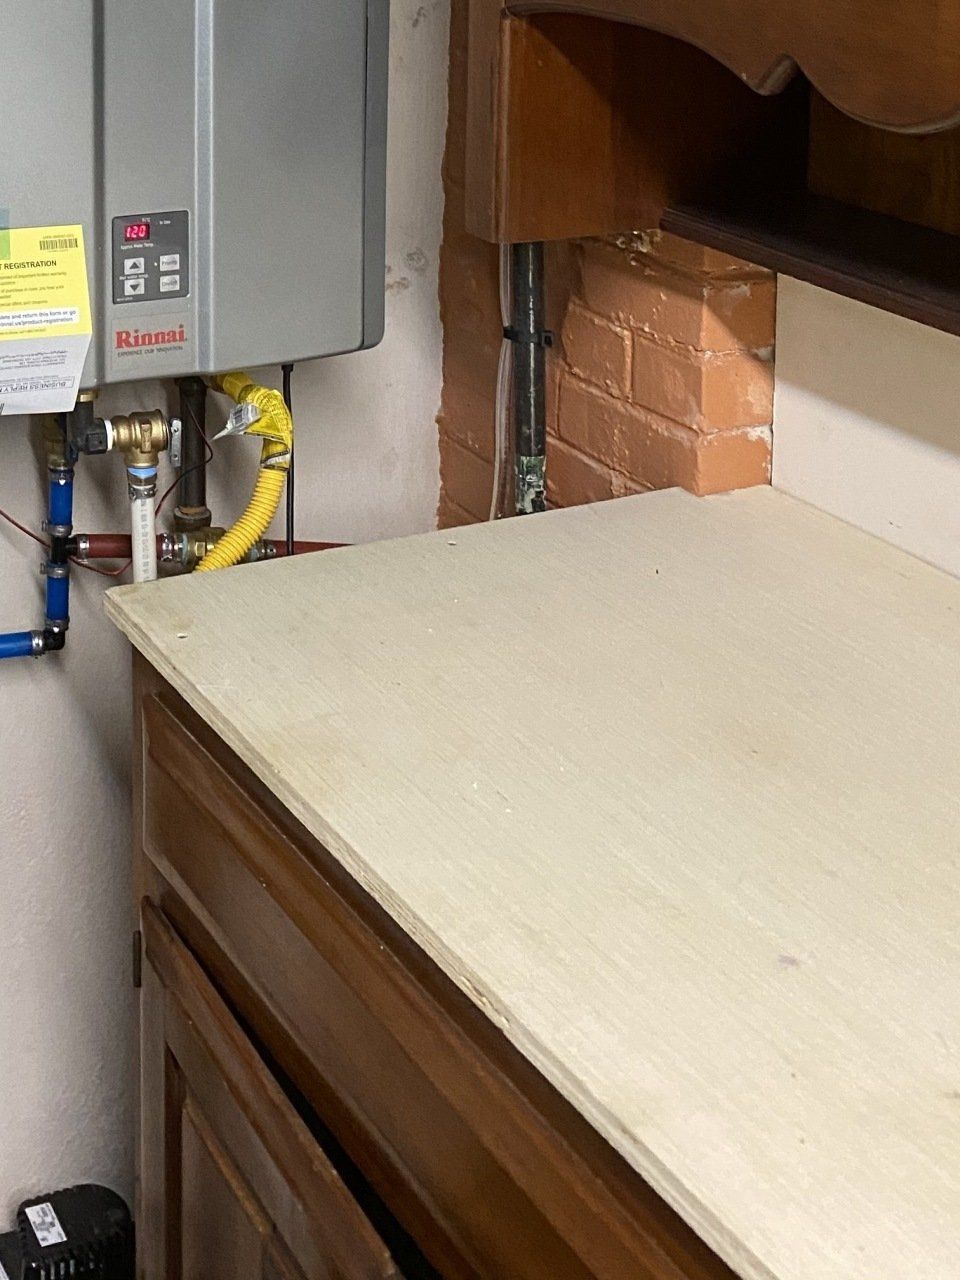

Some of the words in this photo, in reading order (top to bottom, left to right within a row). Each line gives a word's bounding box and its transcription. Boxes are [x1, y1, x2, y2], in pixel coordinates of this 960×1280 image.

[126, 225, 146, 238] 120
[3, 260, 57, 270] REGISTRATION
[115, 324, 185, 348] Rinnai
[4, 384, 29, 392] REPLY
[29, 381, 66, 391] BUSINESS
